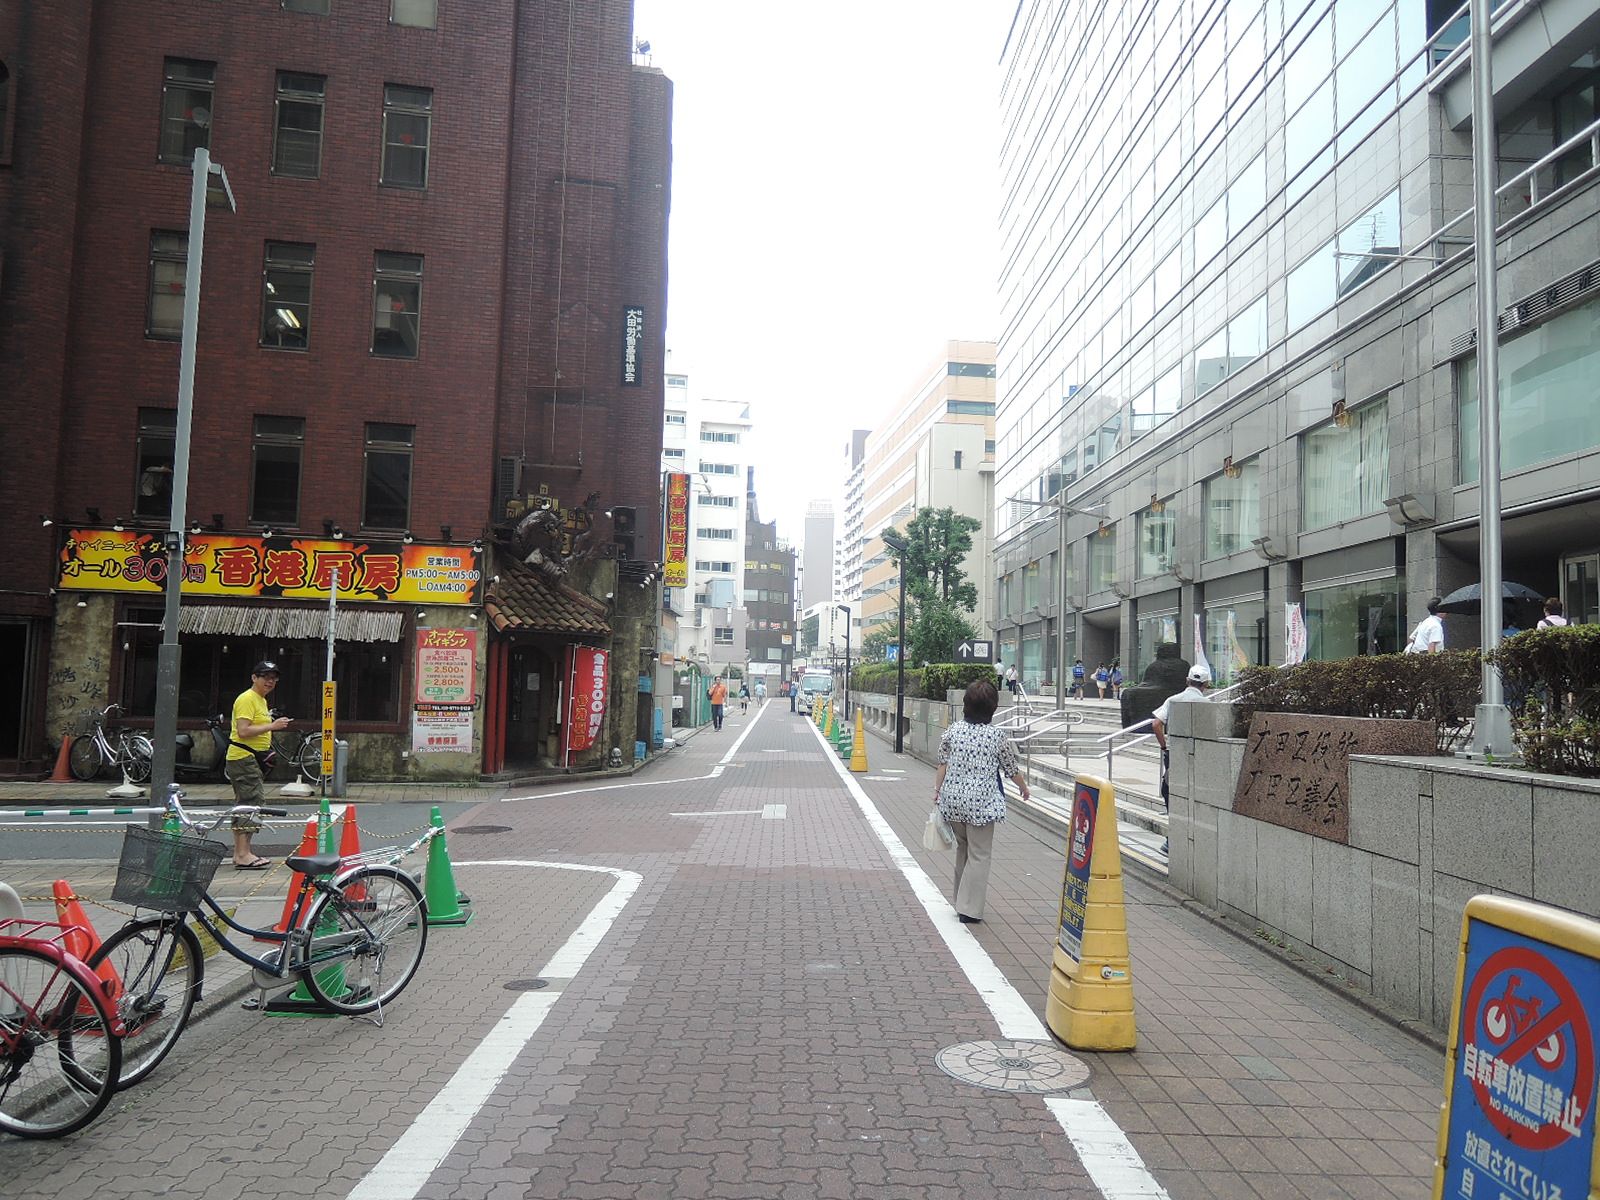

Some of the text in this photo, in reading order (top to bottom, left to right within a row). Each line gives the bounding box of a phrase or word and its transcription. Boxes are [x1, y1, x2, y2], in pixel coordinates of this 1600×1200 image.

[625, 309, 637, 382] 大田労働基準協会
[669, 494, 686, 562] 香港厨房
[215, 548, 400, 592] 香港厨房
[427, 557, 461, 567] 営業時間
[423, 638, 468, 647] バイキング
[428, 629, 464, 639] オーダー
[323, 686, 334, 762] 左折禁止
[1252, 721, 1358, 770] 大田区役所
[1244, 758, 1346, 825] 大田区議会
[1463, 1042, 1582, 1138] 自転車放置禁止
[1489, 1096, 1540, 1133] NO PARKING
